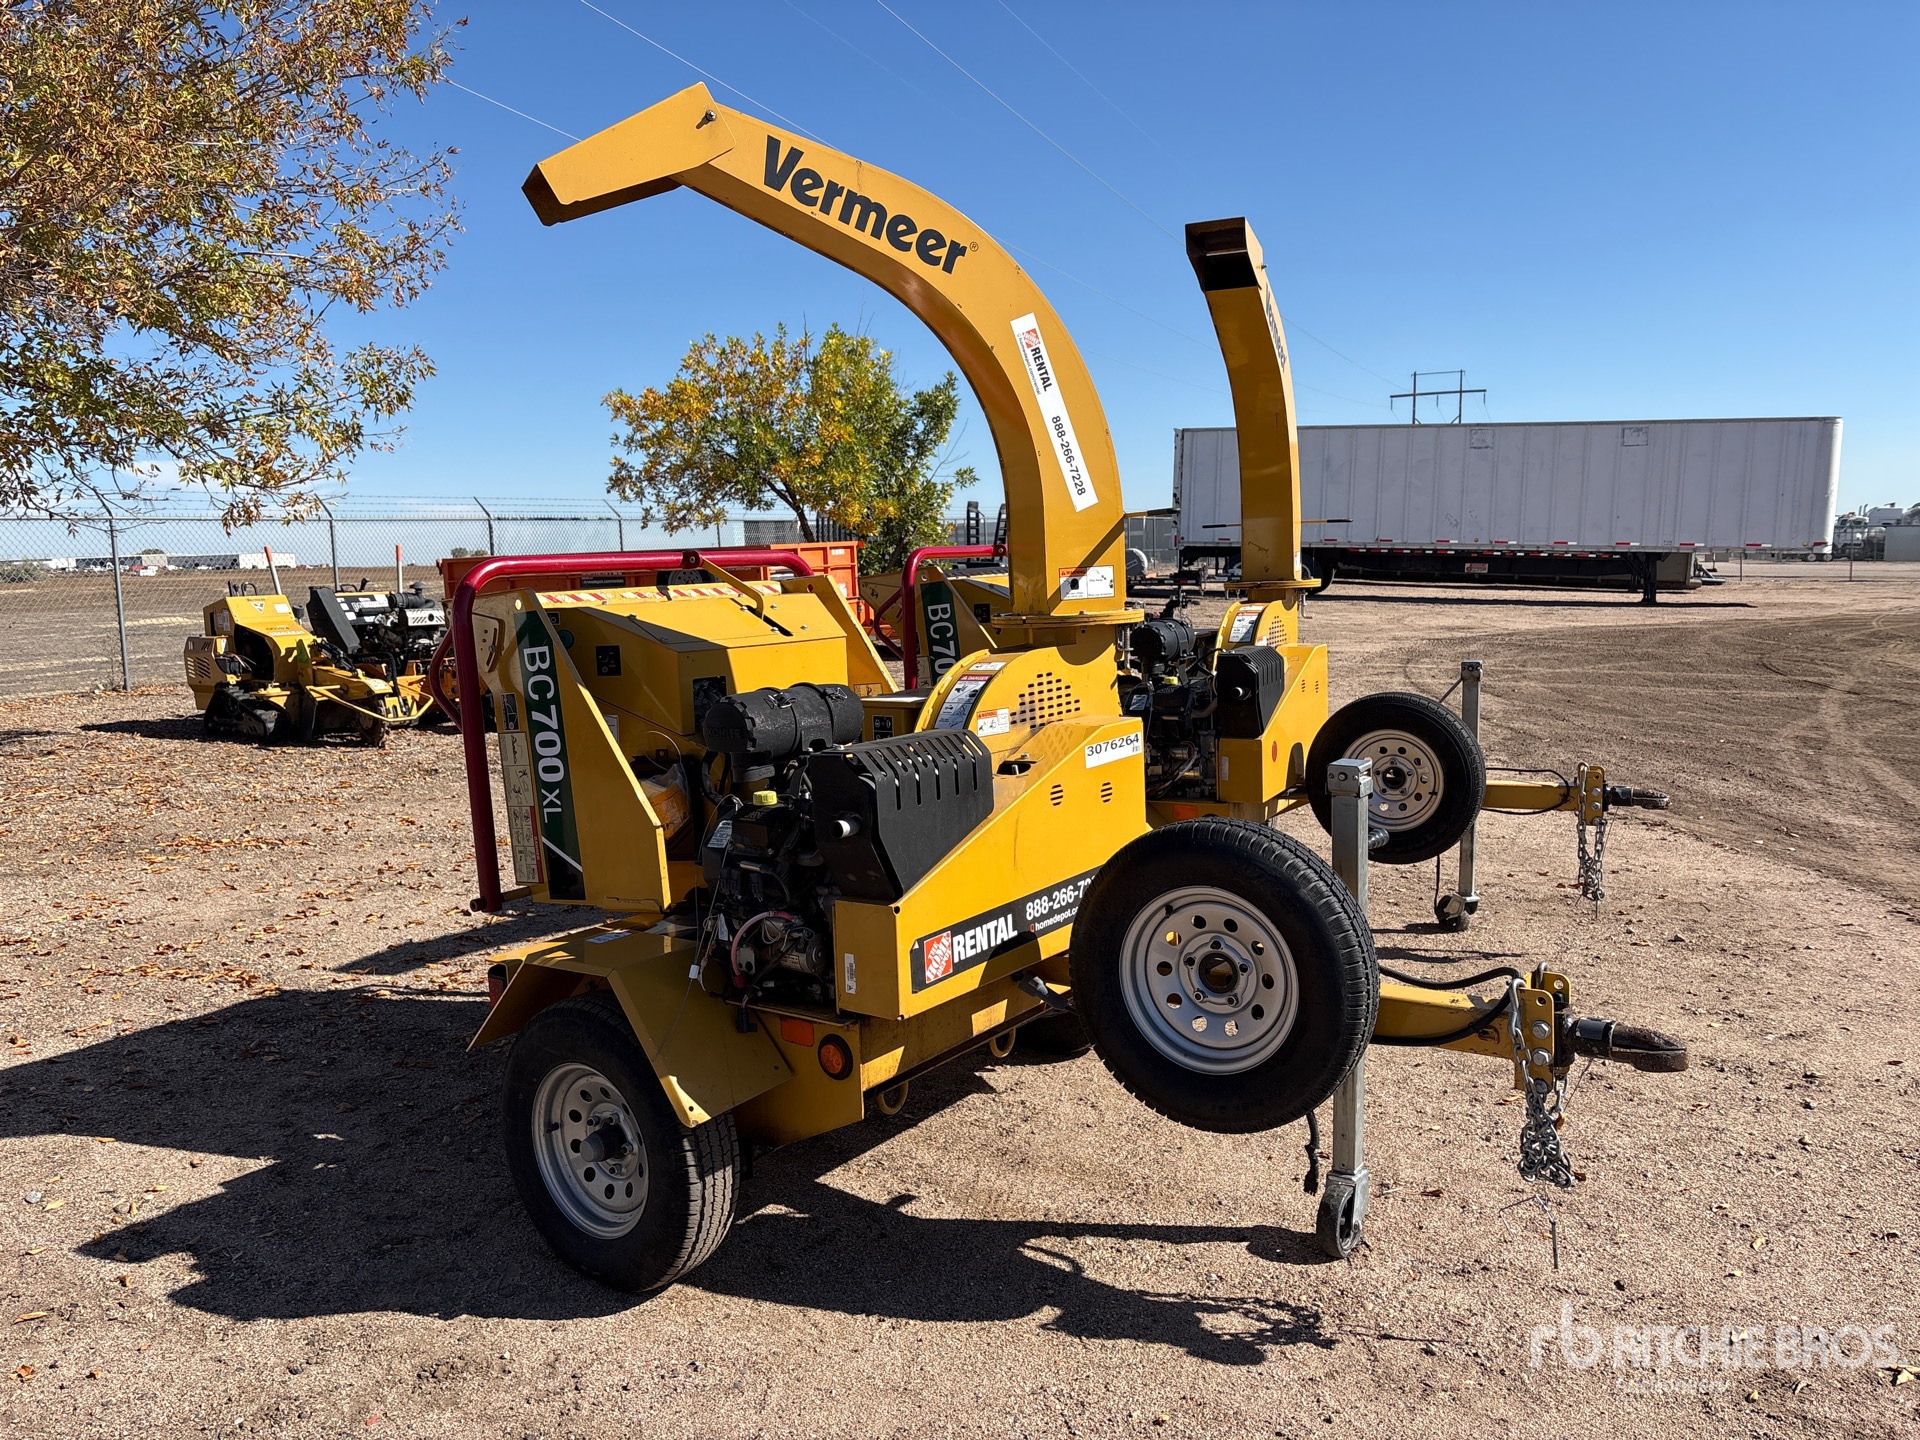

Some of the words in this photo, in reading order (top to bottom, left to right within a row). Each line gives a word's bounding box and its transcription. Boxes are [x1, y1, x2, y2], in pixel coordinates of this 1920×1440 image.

[764, 134, 968, 275] Vermeer
[1030, 346, 1053, 392] RENTAL
[1051, 415, 1086, 496] 888-266-7228
[927, 603, 957, 683] BC70
[1086, 733, 1140, 757] 3076264
[1026, 875, 1095, 920] 888-266-7
[952, 913, 1018, 964] RENTAL
